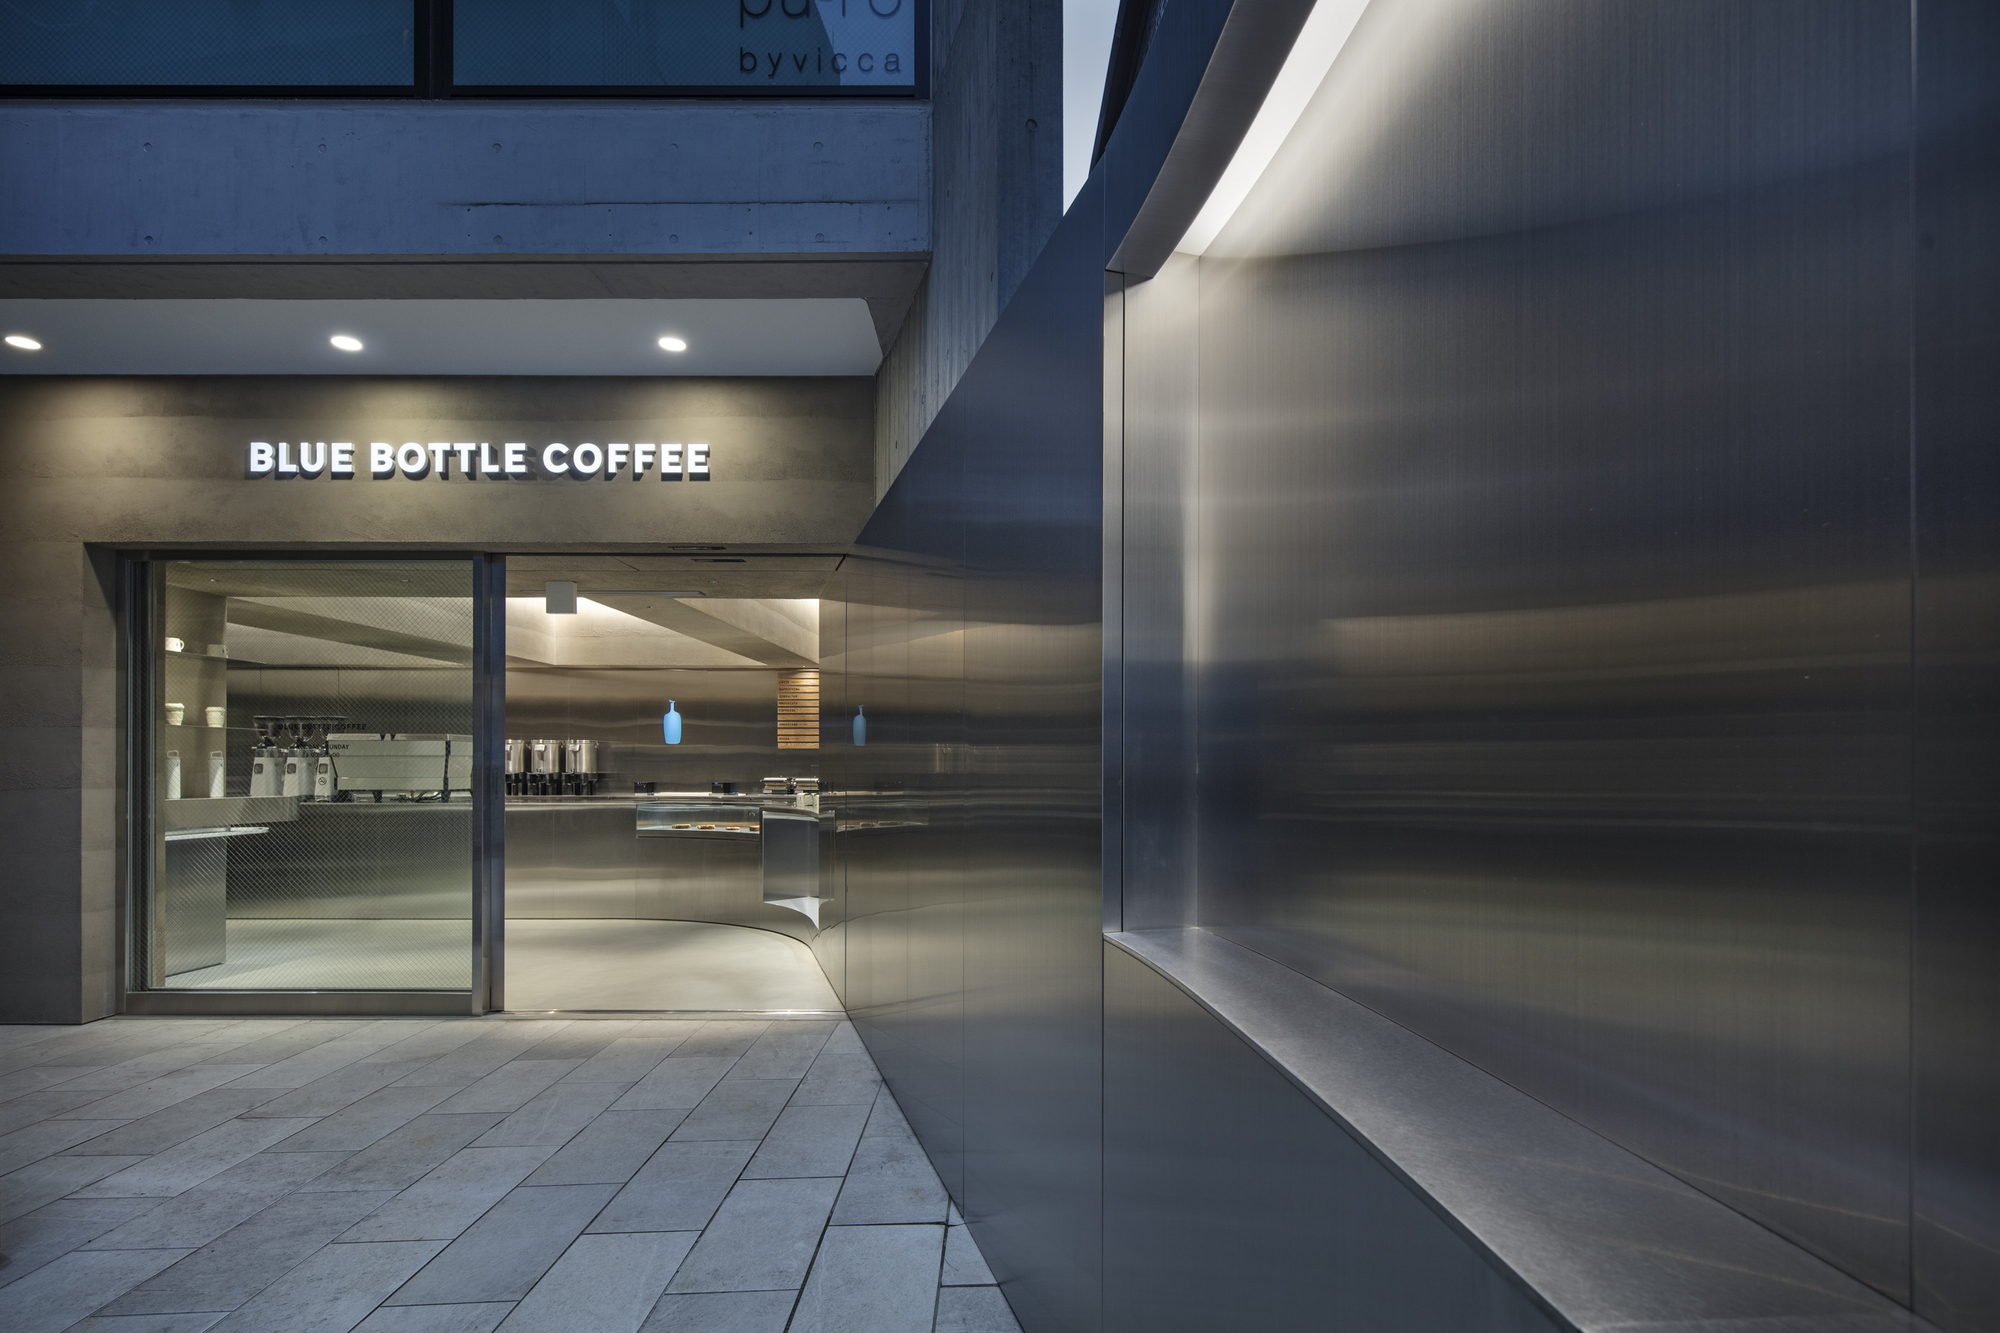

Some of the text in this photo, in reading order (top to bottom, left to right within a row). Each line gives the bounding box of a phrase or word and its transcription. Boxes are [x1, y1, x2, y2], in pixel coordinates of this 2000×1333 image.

[740, 46, 901, 77] byvicca
[249, 441, 710, 474] BLUE BOTTLE COFFEE
